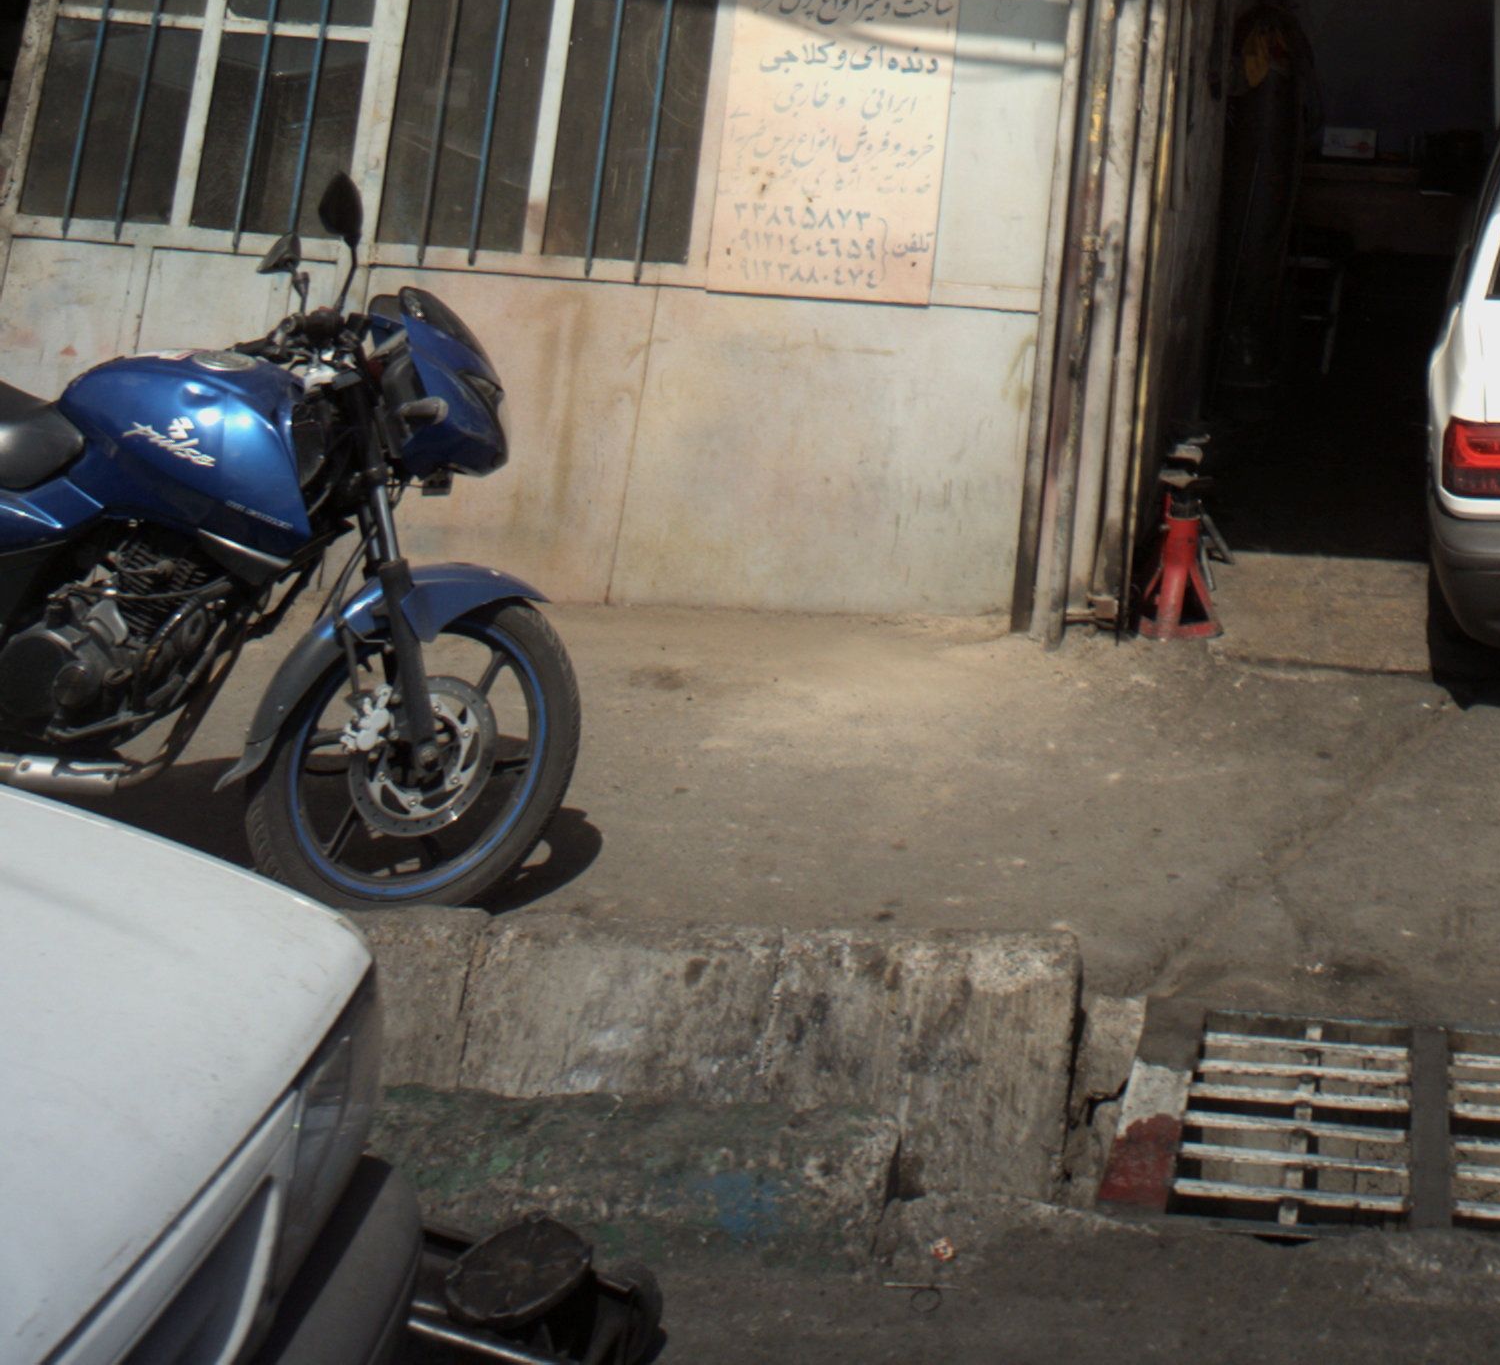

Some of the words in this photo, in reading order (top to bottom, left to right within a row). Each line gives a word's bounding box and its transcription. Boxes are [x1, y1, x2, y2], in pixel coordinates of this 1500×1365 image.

[882, 1, 892, 17] و
[760, 40, 836, 74] کلاجی
[831, 49, 848, 70] و
[773, 80, 830, 118] خارجی
[835, 96, 846, 111] و
[860, 88, 918, 124] ایرانی
[891, 230, 935, 258] تلفن
